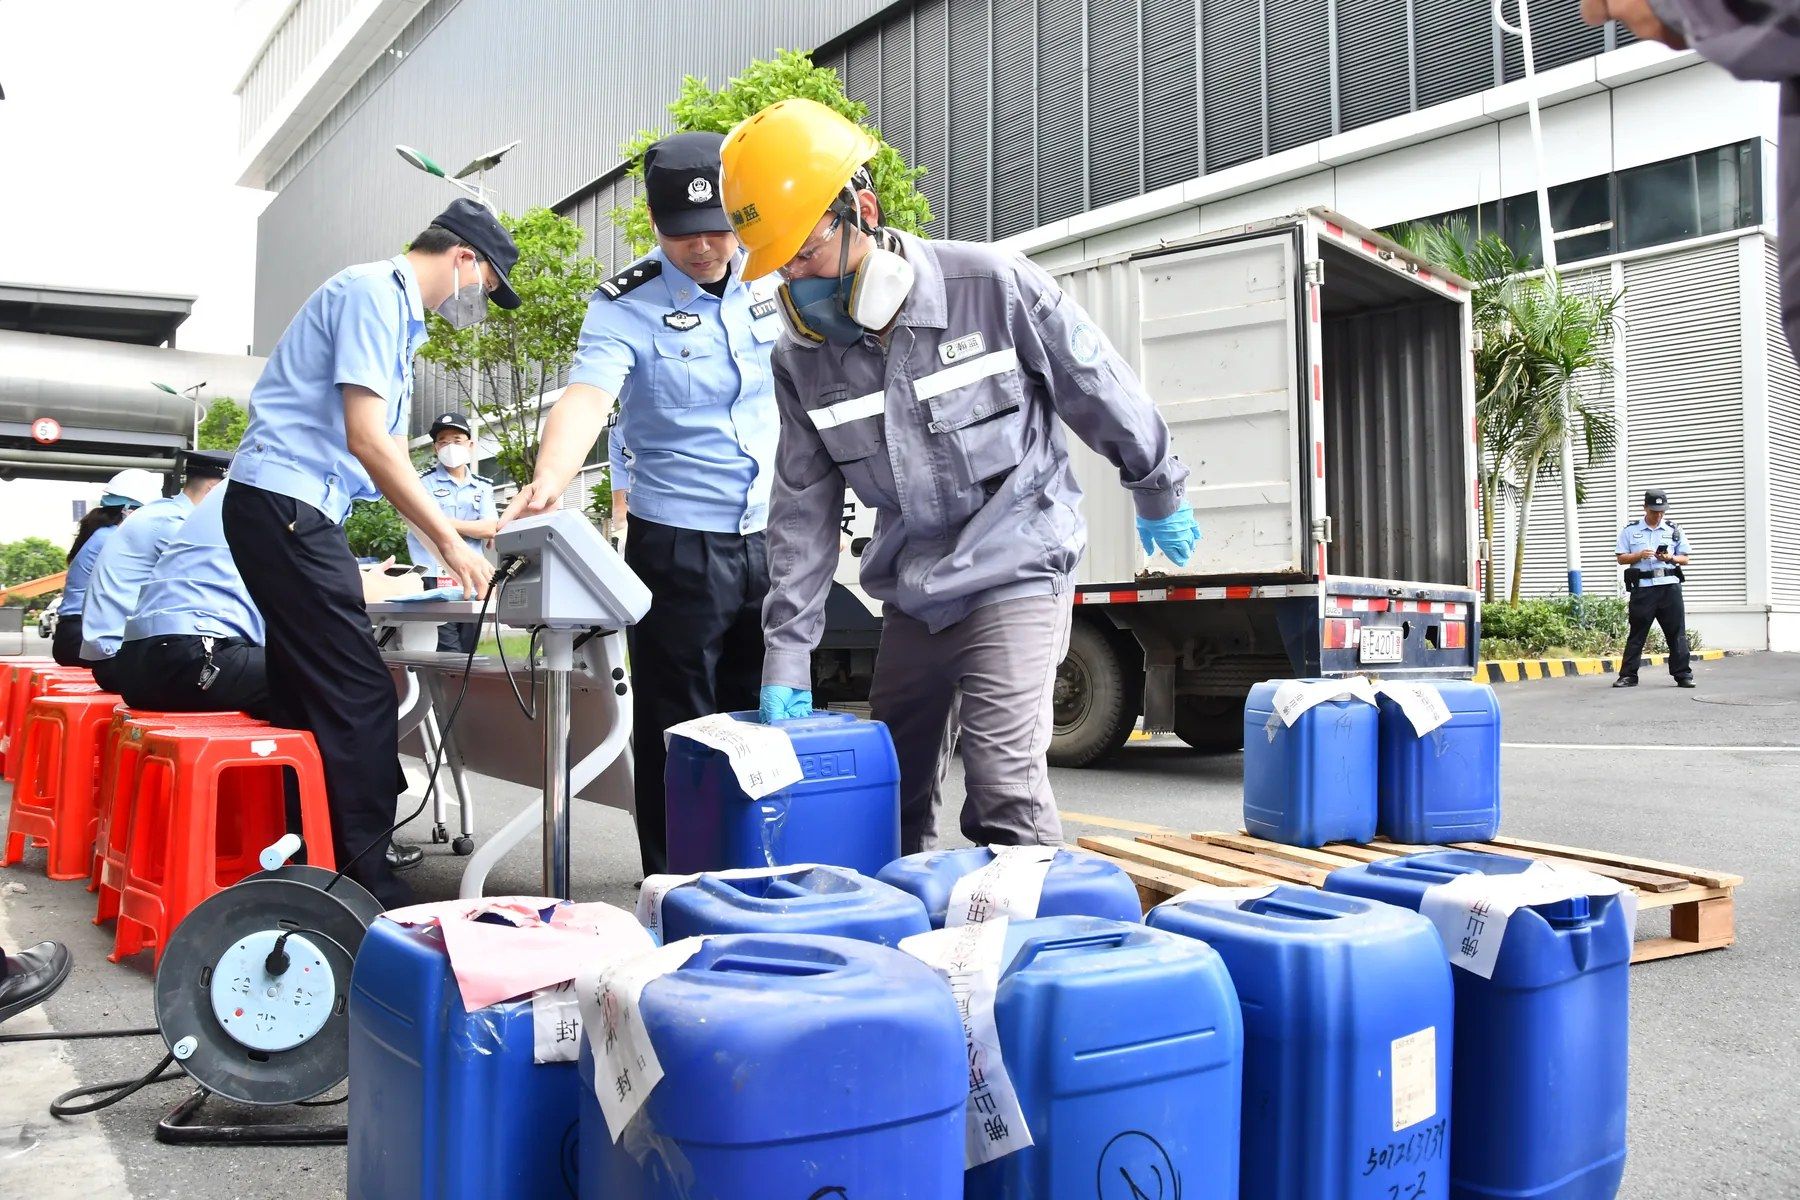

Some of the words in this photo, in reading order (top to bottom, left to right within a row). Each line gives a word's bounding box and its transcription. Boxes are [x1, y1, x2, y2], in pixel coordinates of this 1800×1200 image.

[749, 770, 764, 788] 封
[802, 755, 851, 778] 25L
[1460, 899, 1492, 959] 佛山市
[556, 1018, 580, 1044] 封
[616, 1067, 633, 1104] 封
